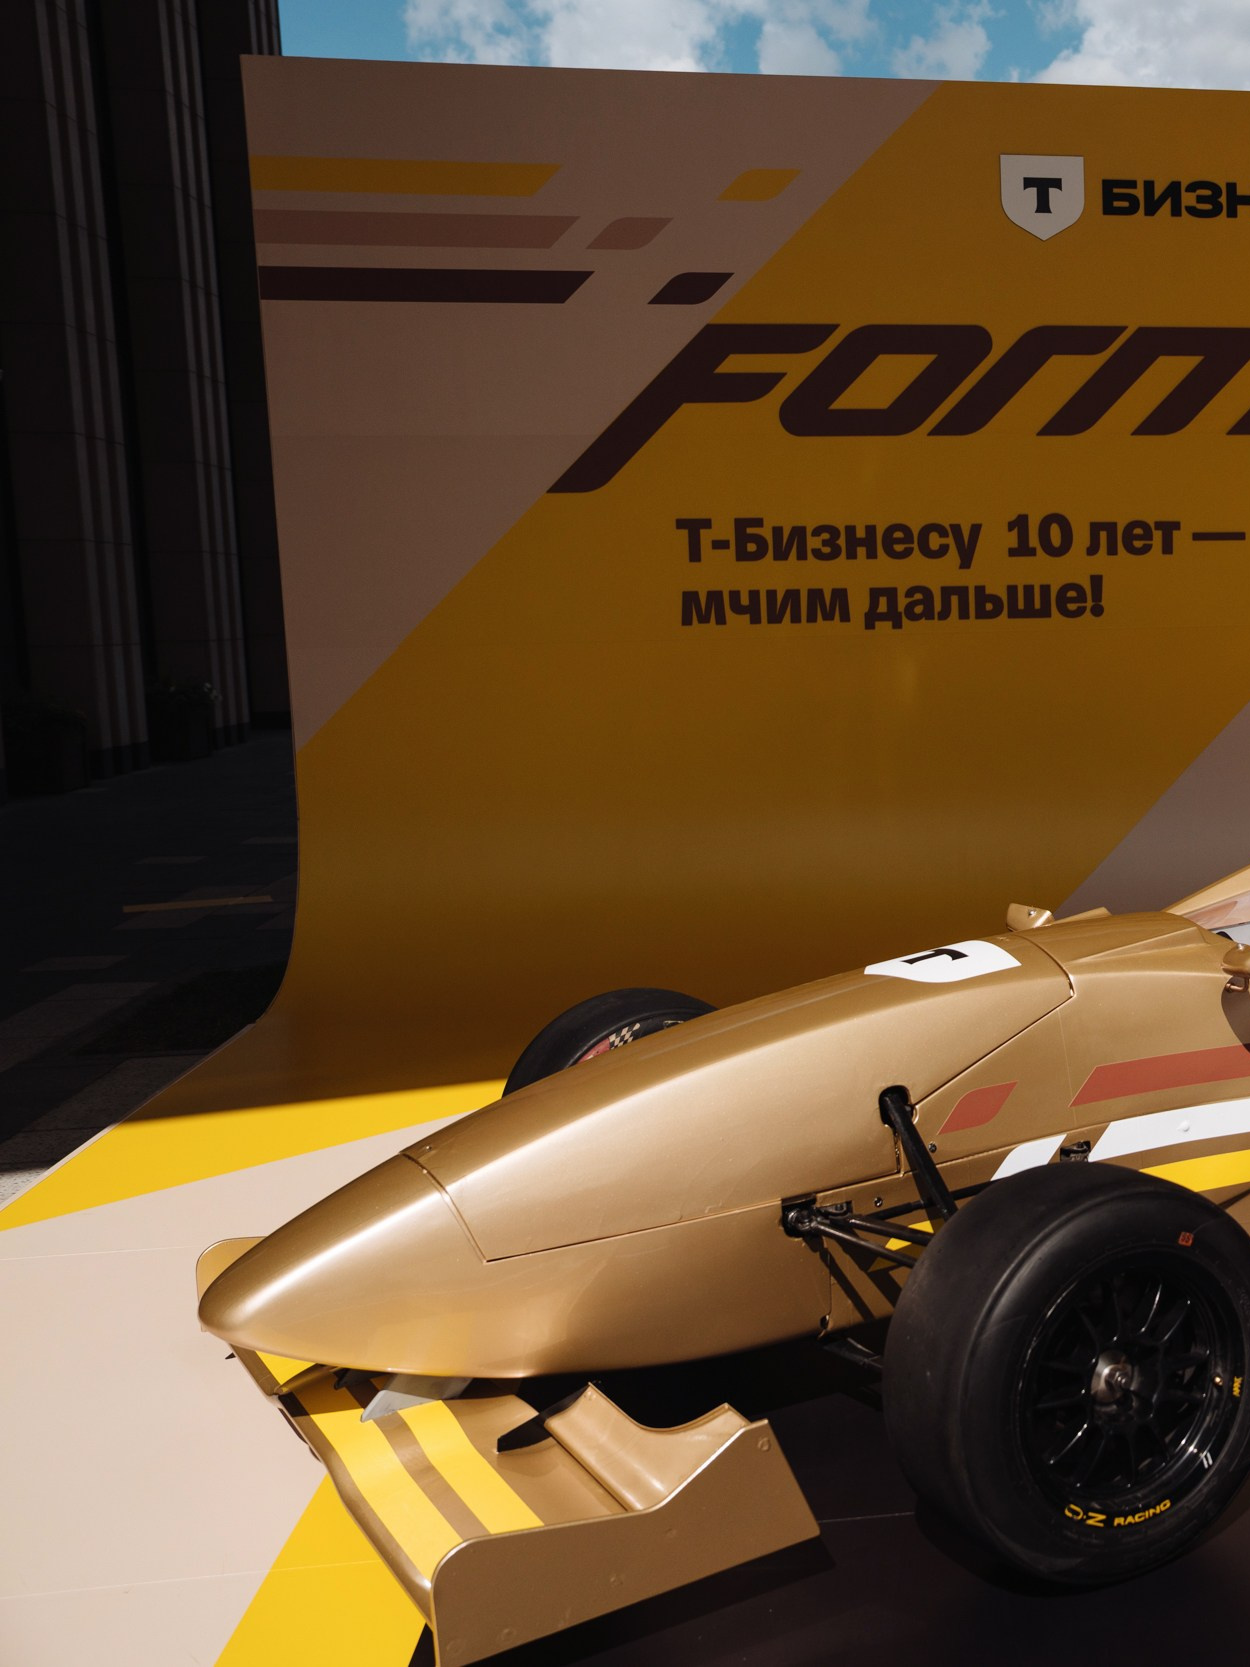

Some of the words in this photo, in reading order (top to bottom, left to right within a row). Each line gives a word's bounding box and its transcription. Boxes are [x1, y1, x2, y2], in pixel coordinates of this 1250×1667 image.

[675, 517, 983, 570] Т-Бизнесу
[1006, 512, 1074, 558] 10
[1085, 519, 1182, 557] лет
[680, 587, 852, 627] мчим
[863, 574, 1106, 631] дальше!
[1112, 1498, 1173, 1528] RACING
